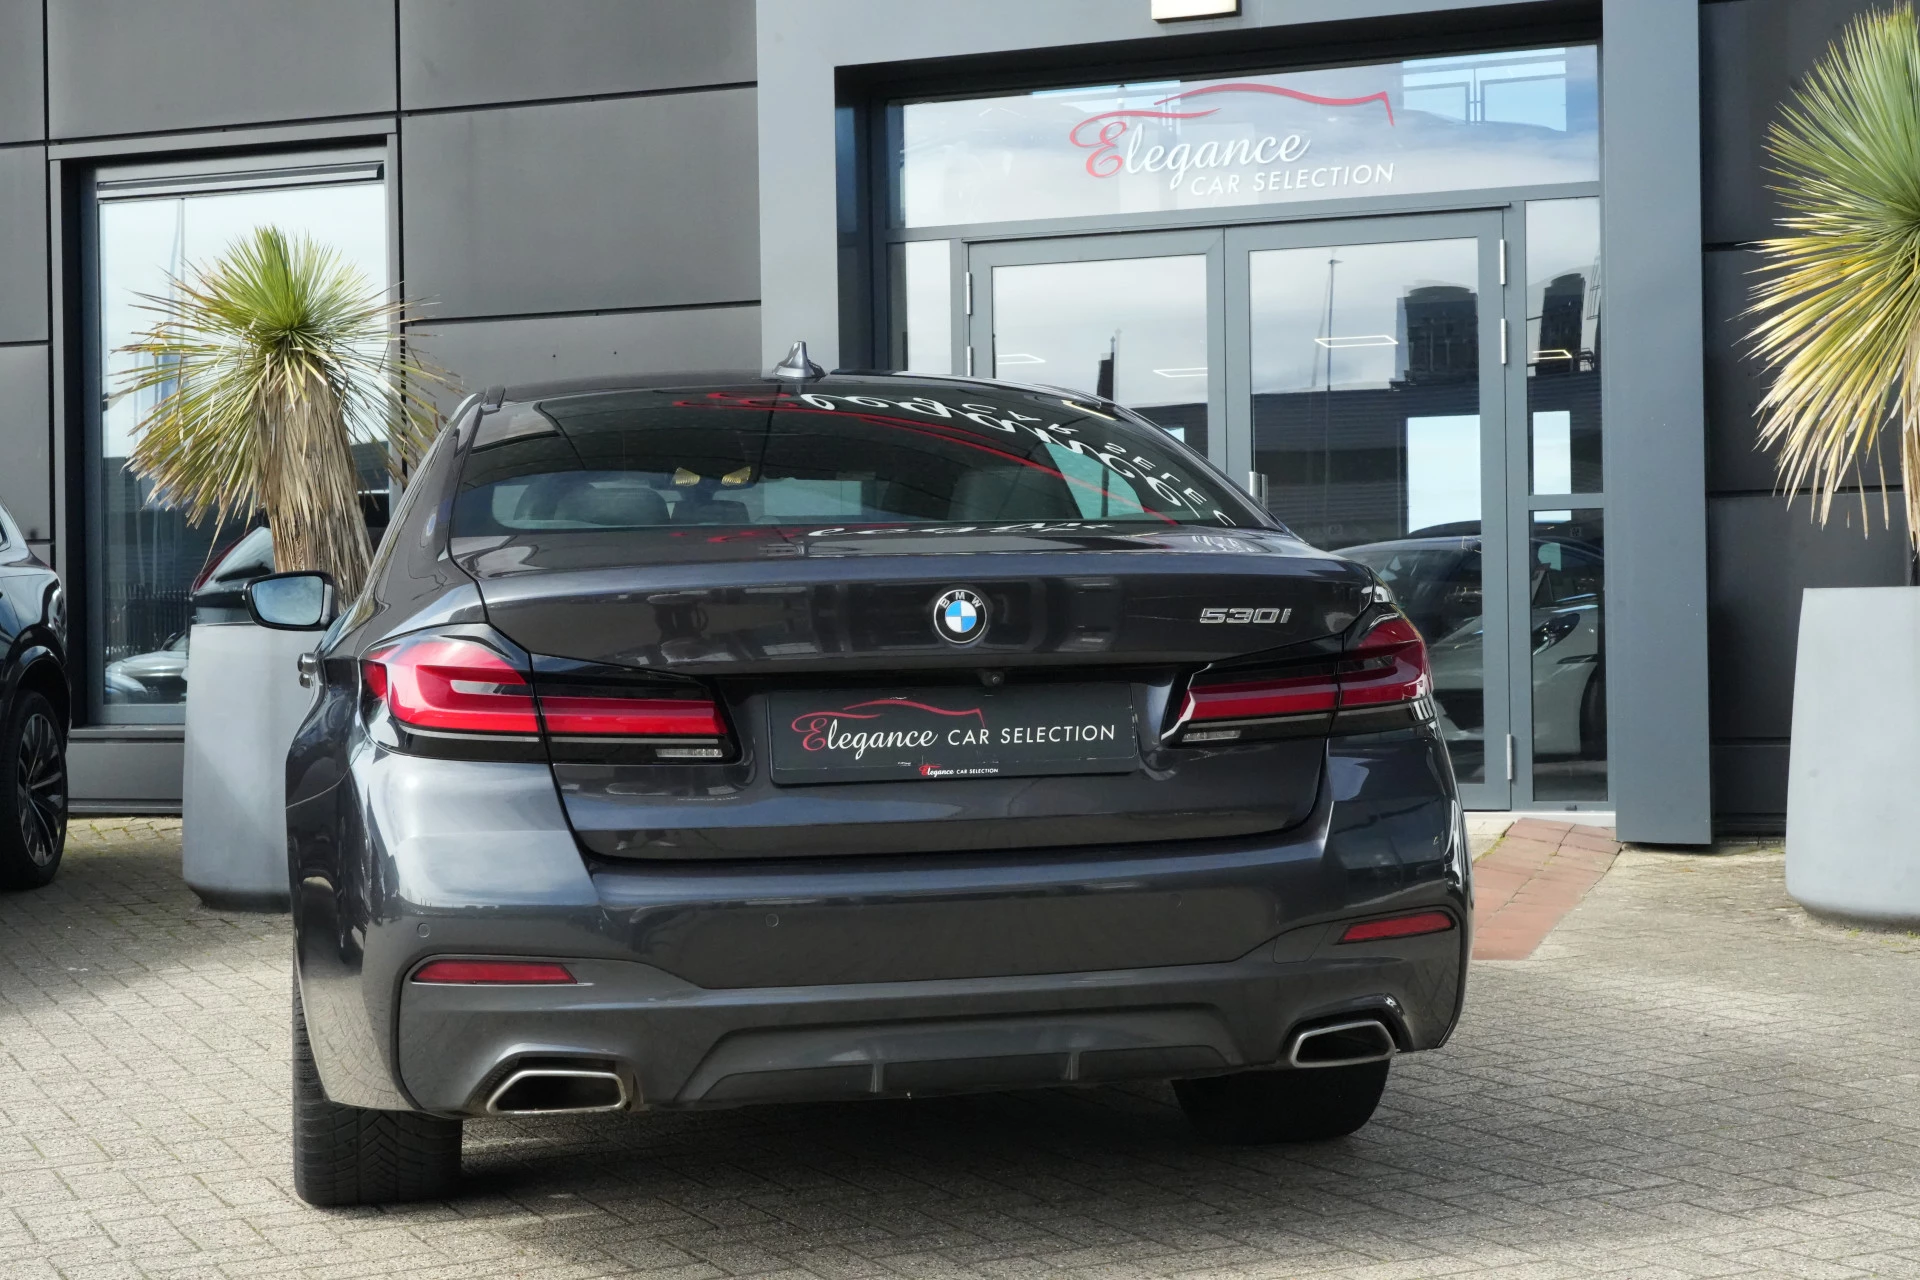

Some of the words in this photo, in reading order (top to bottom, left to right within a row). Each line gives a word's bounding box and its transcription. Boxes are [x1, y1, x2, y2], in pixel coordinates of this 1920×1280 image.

[1069, 110, 1311, 190] Elegance
[1190, 174, 1241, 196] CAR
[1252, 162, 1395, 192] SELECTION
[939, 590, 982, 609] BMW
[791, 712, 939, 760] Elegance
[947, 728, 990, 746] CAR
[1000, 724, 1115, 744] SELECTION
[918, 764, 954, 778] Elegance
[969, 767, 999, 775] SELECTION
